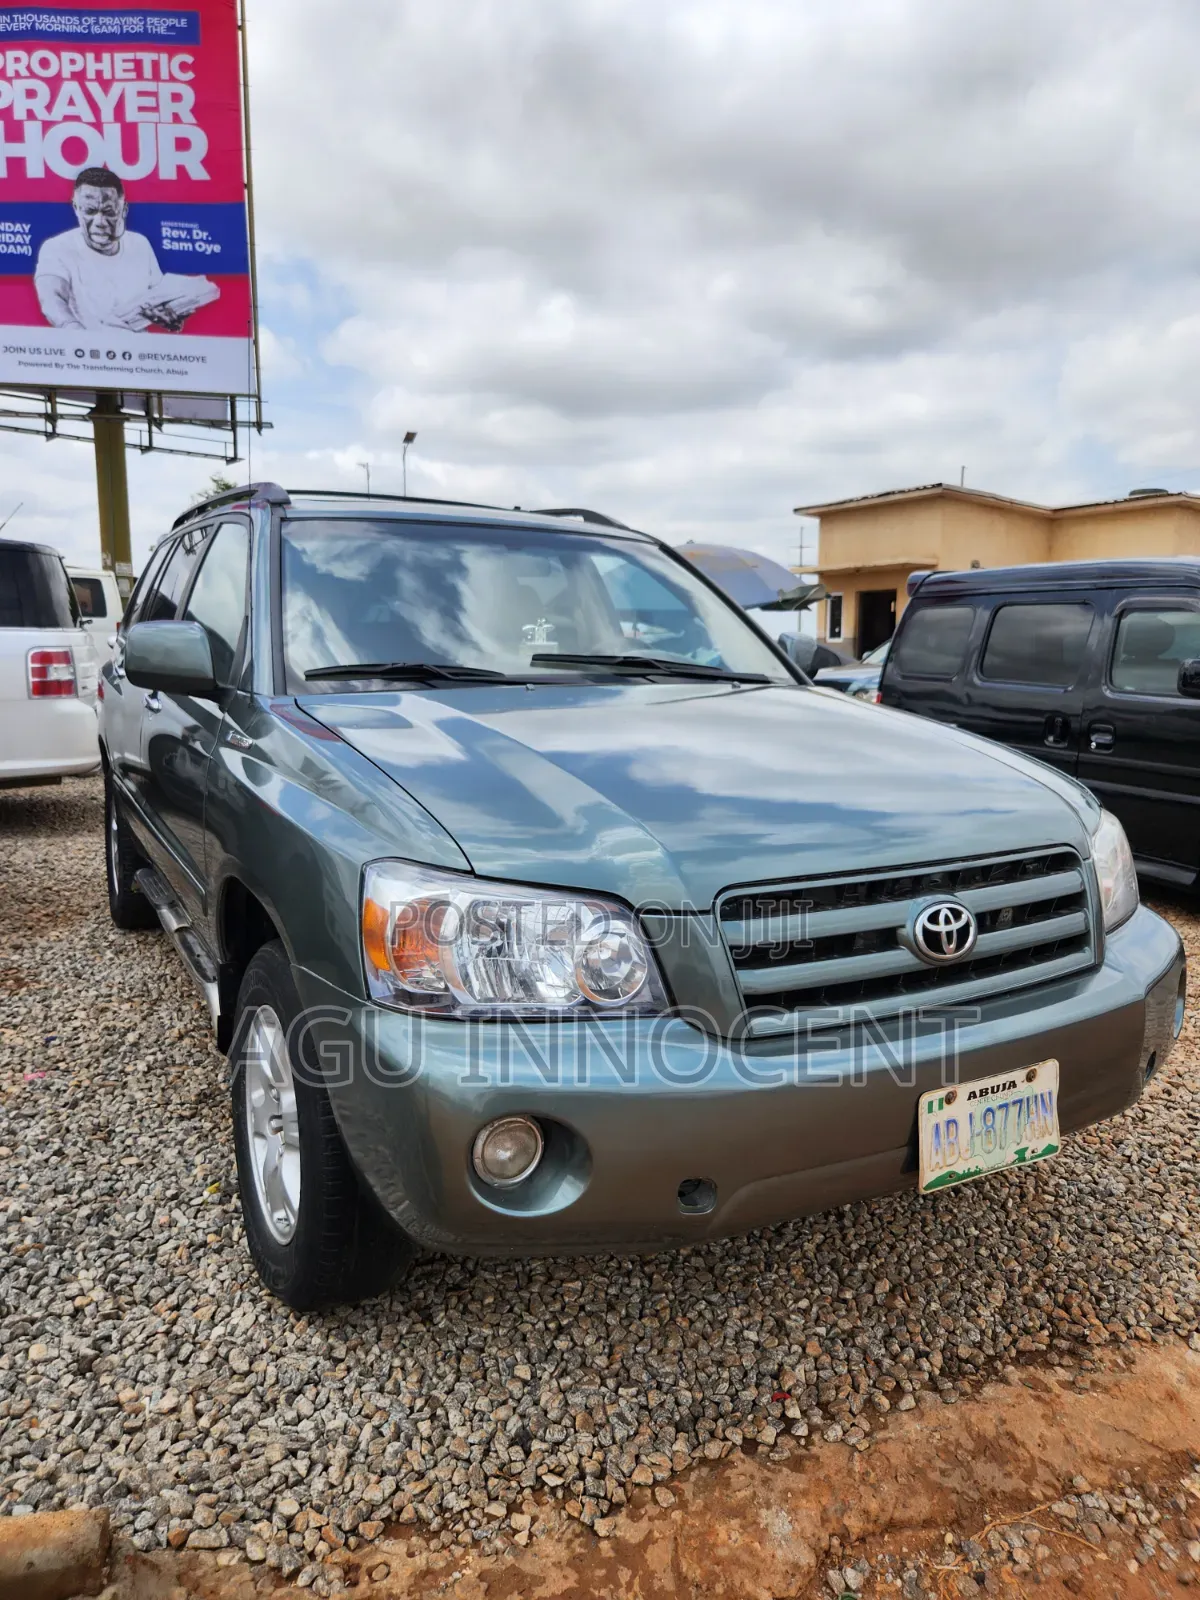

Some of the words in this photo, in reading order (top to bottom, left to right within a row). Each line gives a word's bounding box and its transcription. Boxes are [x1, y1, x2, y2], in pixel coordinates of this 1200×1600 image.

[13, 14, 80, 25] THOUSANDS
[82, 17, 96, 25] OF
[99, 17, 144, 25] PRAYING
[147, 18, 188, 27] PEOPLE
[0, 23, 32, 31] EVERY
[36, 24, 89, 33] MORNING
[91, 25, 120, 34] (6AM)
[124, 25, 144, 33] FOR
[0, 50, 195, 81] ROPHETIC
[0, 121, 211, 180] HOUR
[0, 233, 32, 244] IDAY
[162, 227, 190, 239] Rev.
[193, 229, 212, 240] Dr.
[163, 239, 193, 251] Sam
[195, 241, 221, 254] Oye
[3, 346, 26, 354] JOIN
[44, 348, 66, 356] LIVE
[138, 353, 207, 363] @REVSAMOYE
[55, 362, 64, 370] By
[82, 364, 134, 373] Transforming
[135, 366, 163, 374] Church,
[166, 368, 188, 376] Abuja
[967, 1080, 1018, 1101] ABUJA
